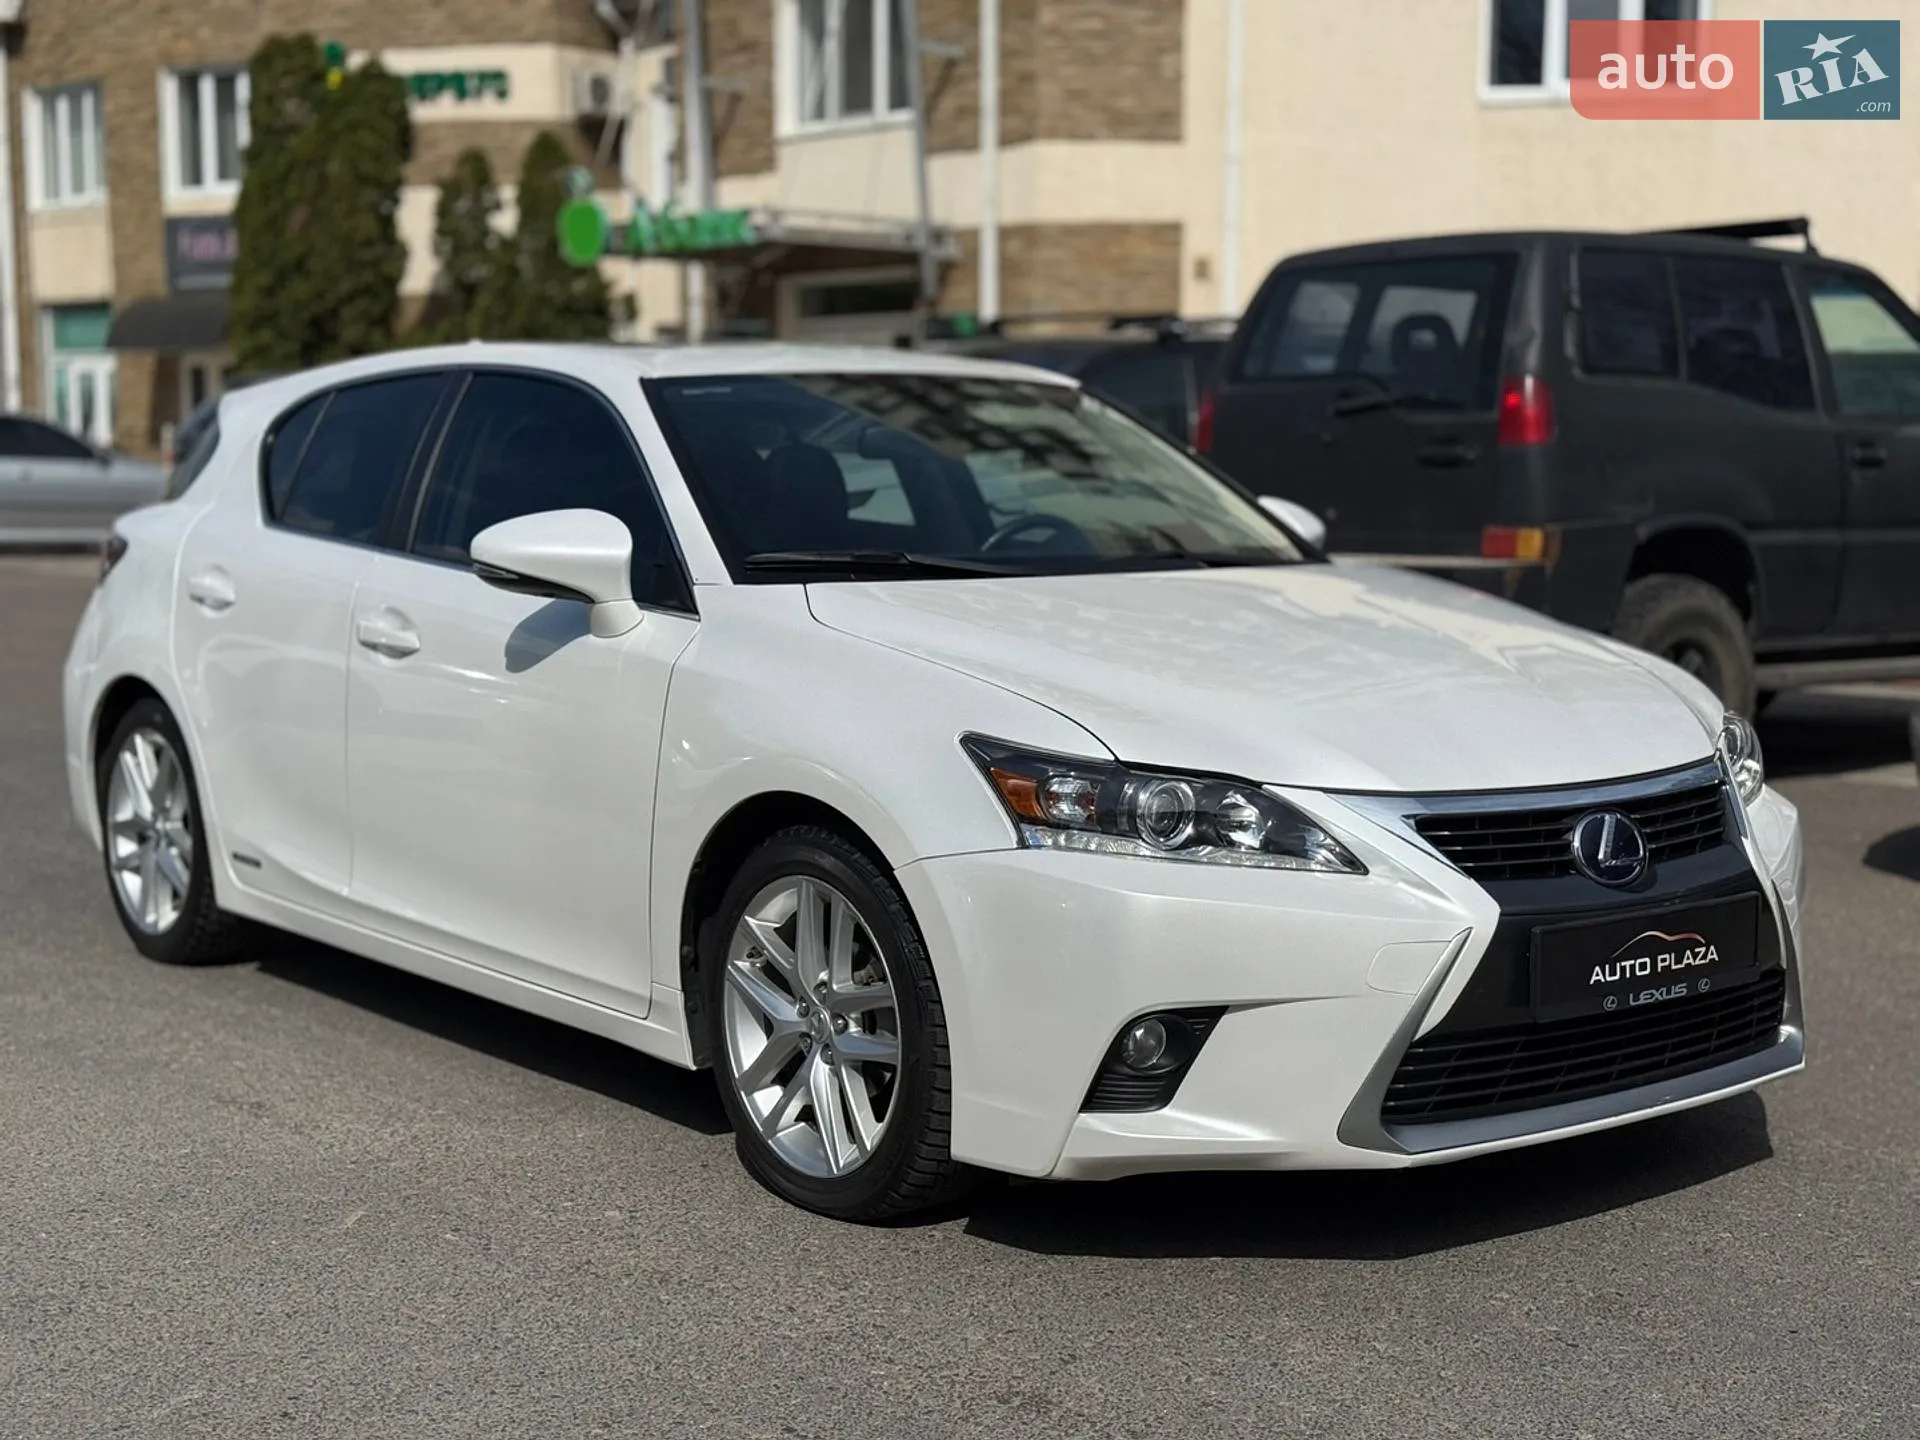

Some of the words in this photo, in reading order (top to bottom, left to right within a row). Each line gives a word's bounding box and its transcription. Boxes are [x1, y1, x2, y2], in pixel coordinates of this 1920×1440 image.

[1589, 957, 1651, 985] AUTO
[1657, 944, 1719, 973] PLAZA
[1628, 982, 1688, 1007] LEXUS
